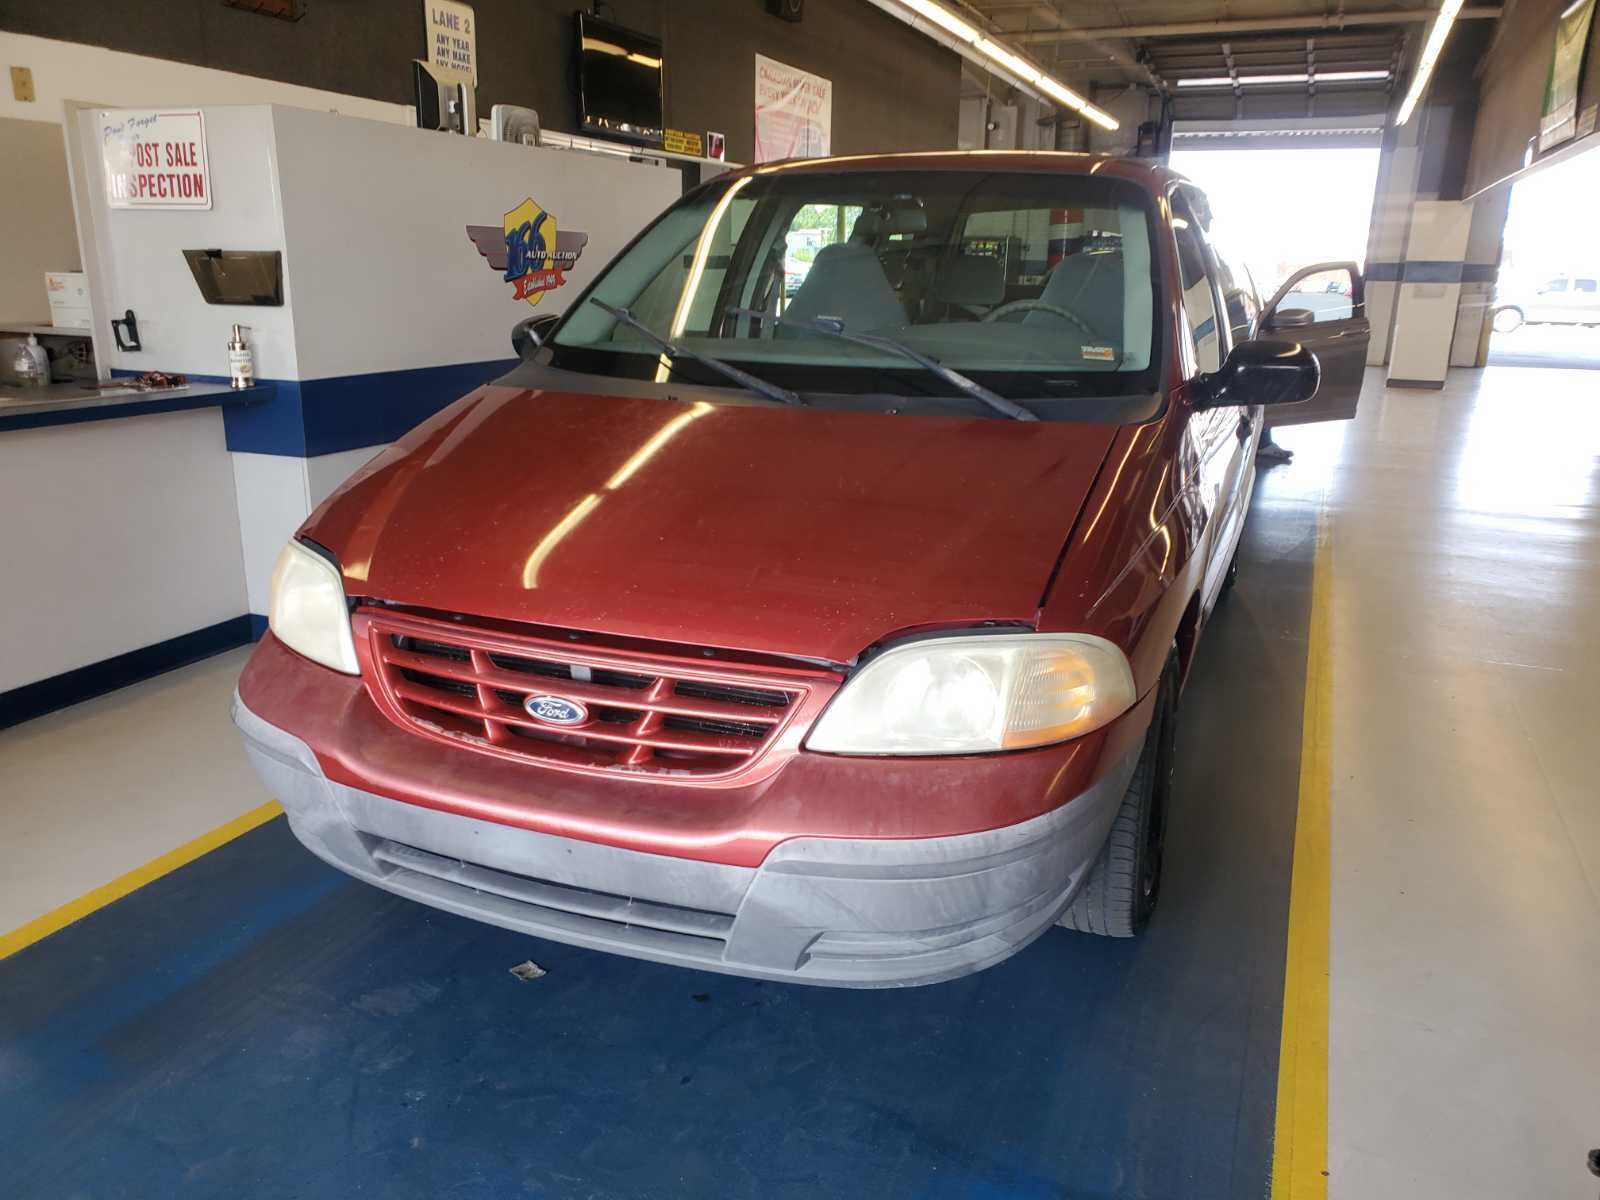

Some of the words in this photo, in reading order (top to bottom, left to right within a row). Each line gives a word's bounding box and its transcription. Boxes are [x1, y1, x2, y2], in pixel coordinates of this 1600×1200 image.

[432, 8, 460, 31] LANE
[464, 18, 471, 34] 2
[437, 33, 450, 46] ANY
[452, 37, 470, 51] YEAR
[437, 45, 450, 59] ANY
[453, 50, 470, 64] MAKE
[132, 142, 160, 168] OST
[165, 142, 198, 167] SALE
[111, 173, 204, 198] INSPECTION
[526, 250, 547, 260] AUTO
[537, 699, 571, 719] Ford
